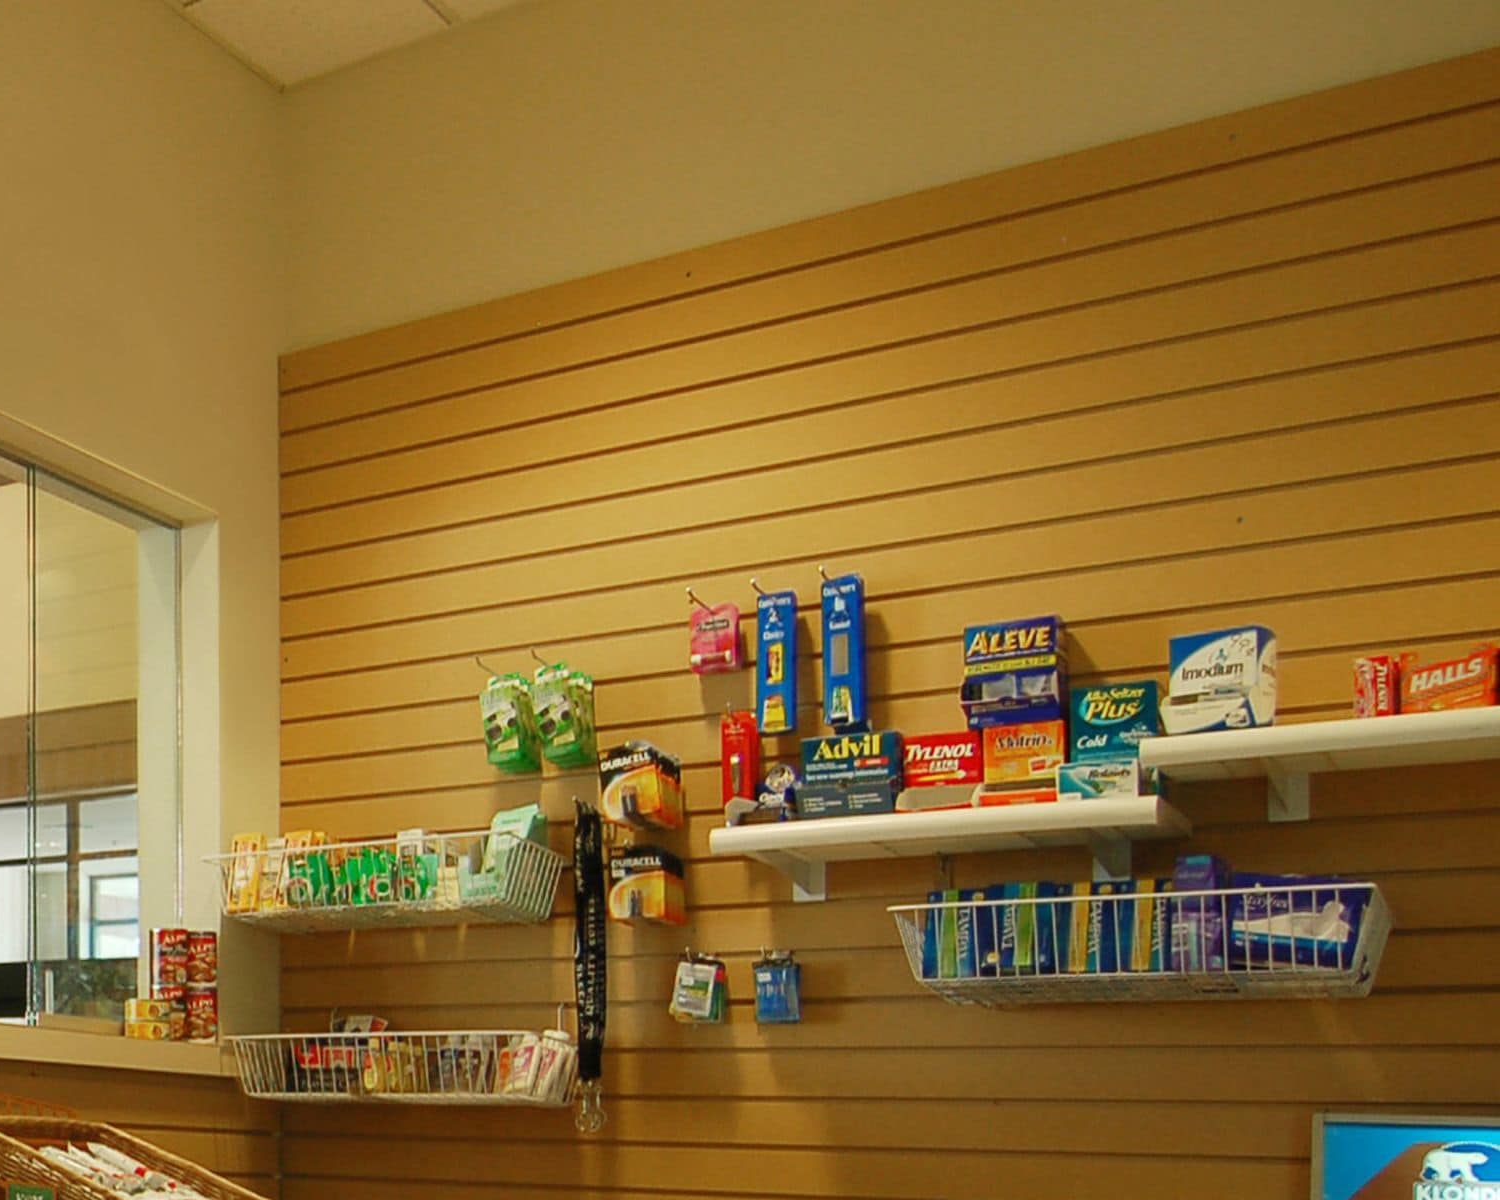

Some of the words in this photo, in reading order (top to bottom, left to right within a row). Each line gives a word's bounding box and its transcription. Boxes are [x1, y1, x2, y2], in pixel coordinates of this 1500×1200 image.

[966, 625, 1052, 657] ALEVE
[1181, 662, 1244, 682] Imodium
[1410, 657, 1484, 694] HALLS
[1085, 699, 1141, 721] Plus
[812, 733, 882, 761] Advil
[995, 733, 1049, 751] Motrin
[1076, 734, 1109, 750] Cold
[600, 751, 652, 772] DURACELL
[905, 743, 974, 763] TYLENOL
[611, 855, 662, 869] DURACELL
